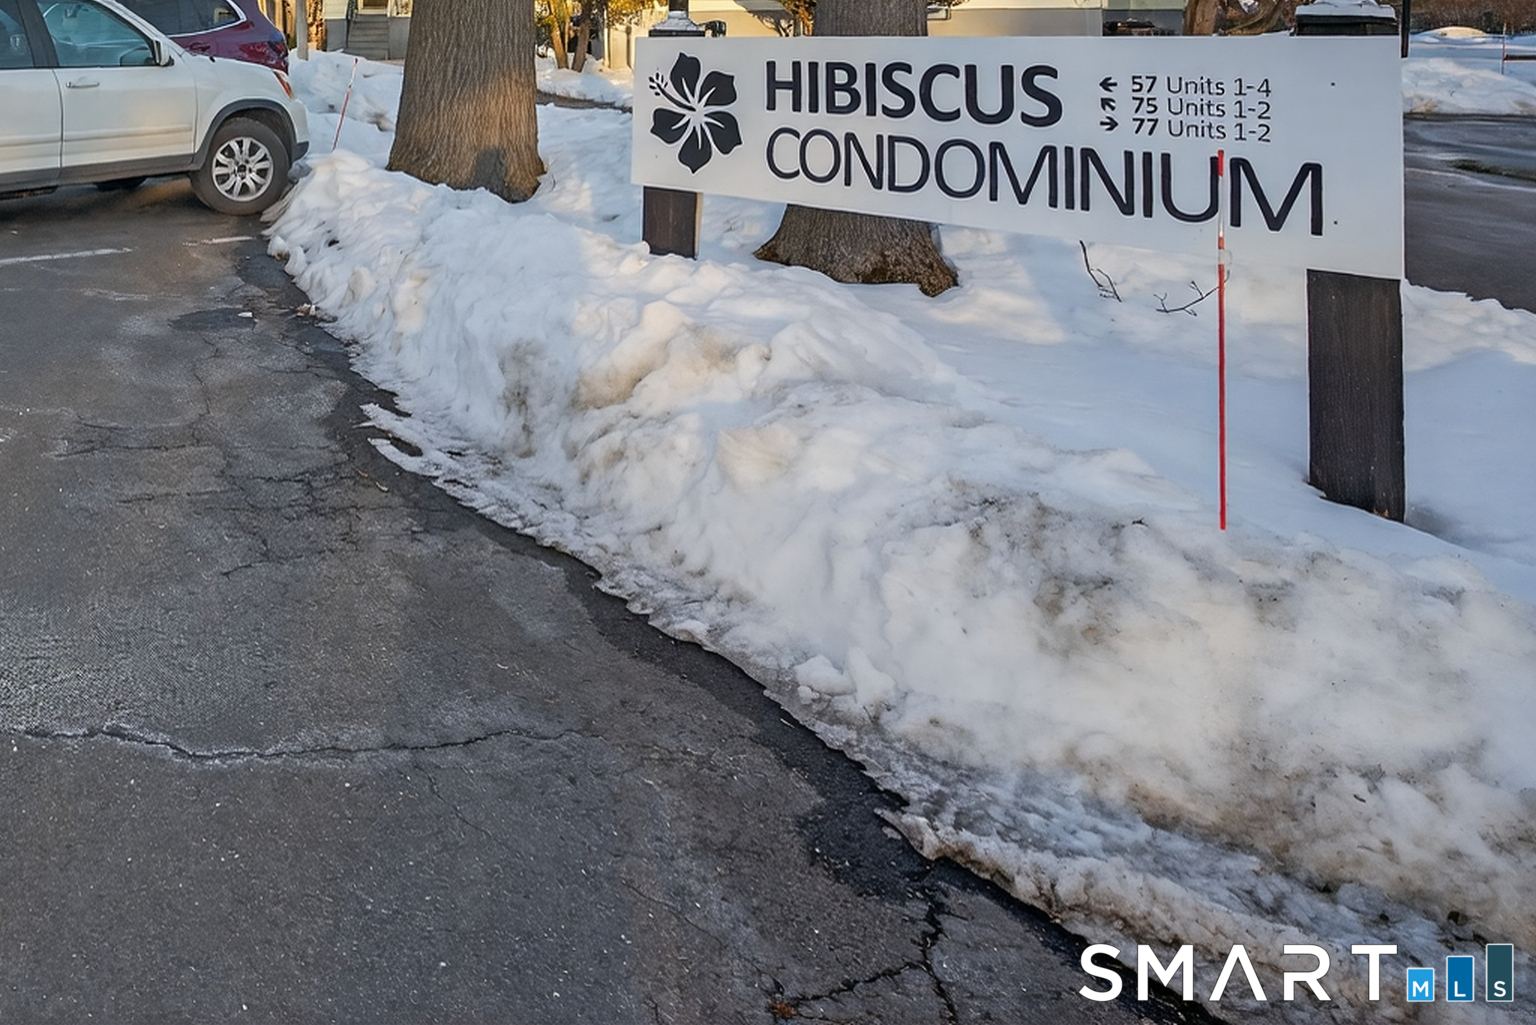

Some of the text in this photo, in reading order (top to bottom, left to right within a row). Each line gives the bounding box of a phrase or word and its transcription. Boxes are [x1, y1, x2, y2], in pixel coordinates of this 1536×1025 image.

[765, 60, 1063, 128] HIBISCUS
[1131, 75, 1271, 97] 57 Units 1-4
[1131, 96, 1271, 120] 75 Units 1-2
[1132, 118, 1271, 143] 77 Units 1-2
[766, 127, 1324, 236] CONDOMINIUM
